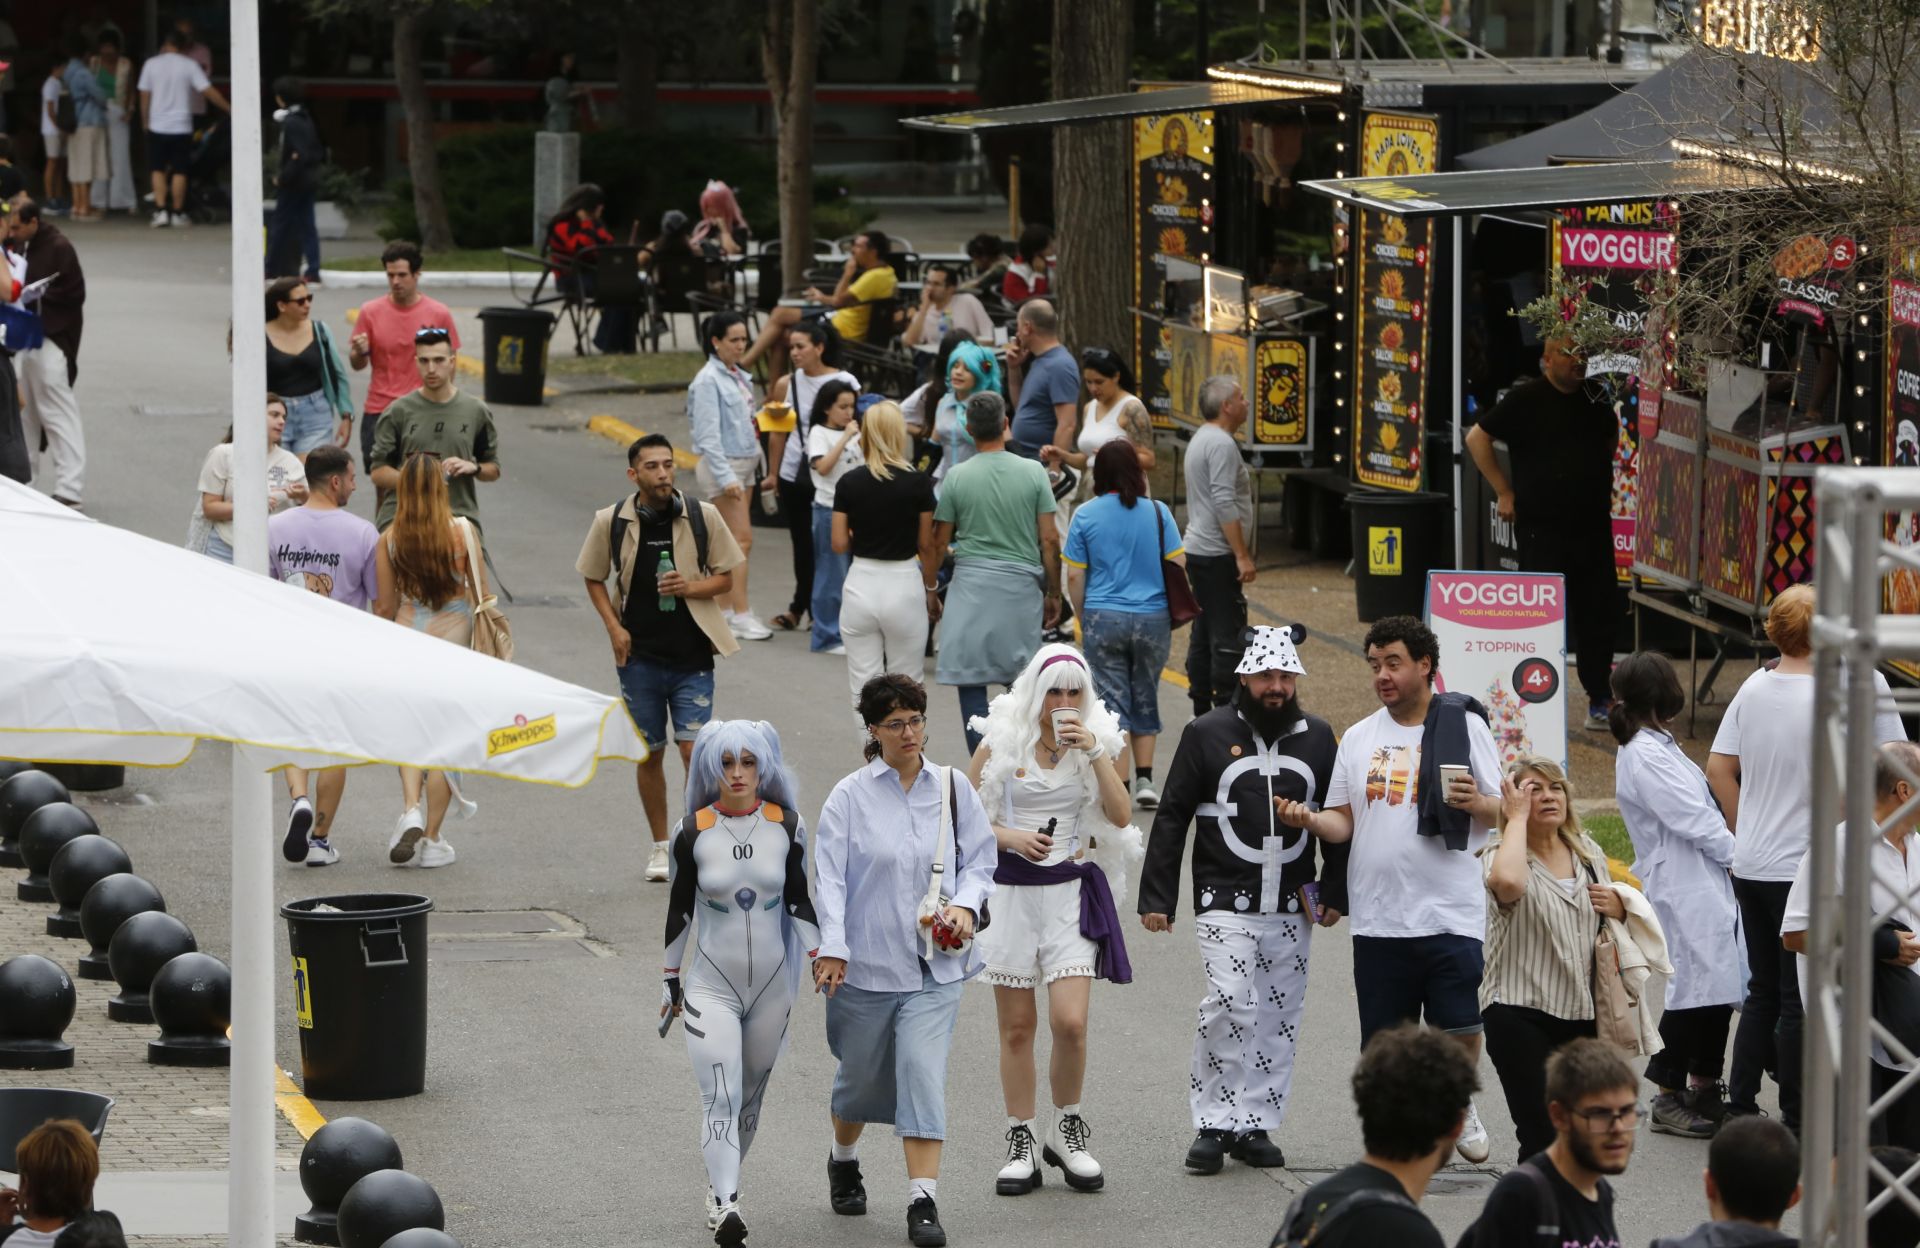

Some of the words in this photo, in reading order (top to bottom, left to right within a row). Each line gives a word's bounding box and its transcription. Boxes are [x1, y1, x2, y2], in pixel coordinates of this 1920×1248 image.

[1374, 134, 1394, 165] PAPA
[1395, 132, 1425, 169] LOVERS
[1564, 232, 1672, 265] YOGGUR
[1778, 277, 1840, 306] CLASSIC
[278, 543, 341, 568] Happiness
[1437, 582, 1557, 607] YOGGUR
[1484, 609, 1514, 617] HELADO
[1514, 609, 1548, 618] NATURAL
[1464, 641, 1473, 652] 2
[1476, 641, 1536, 653] TOPPING
[488, 722, 554, 754] Schweppes
[732, 843, 754, 860] 00
